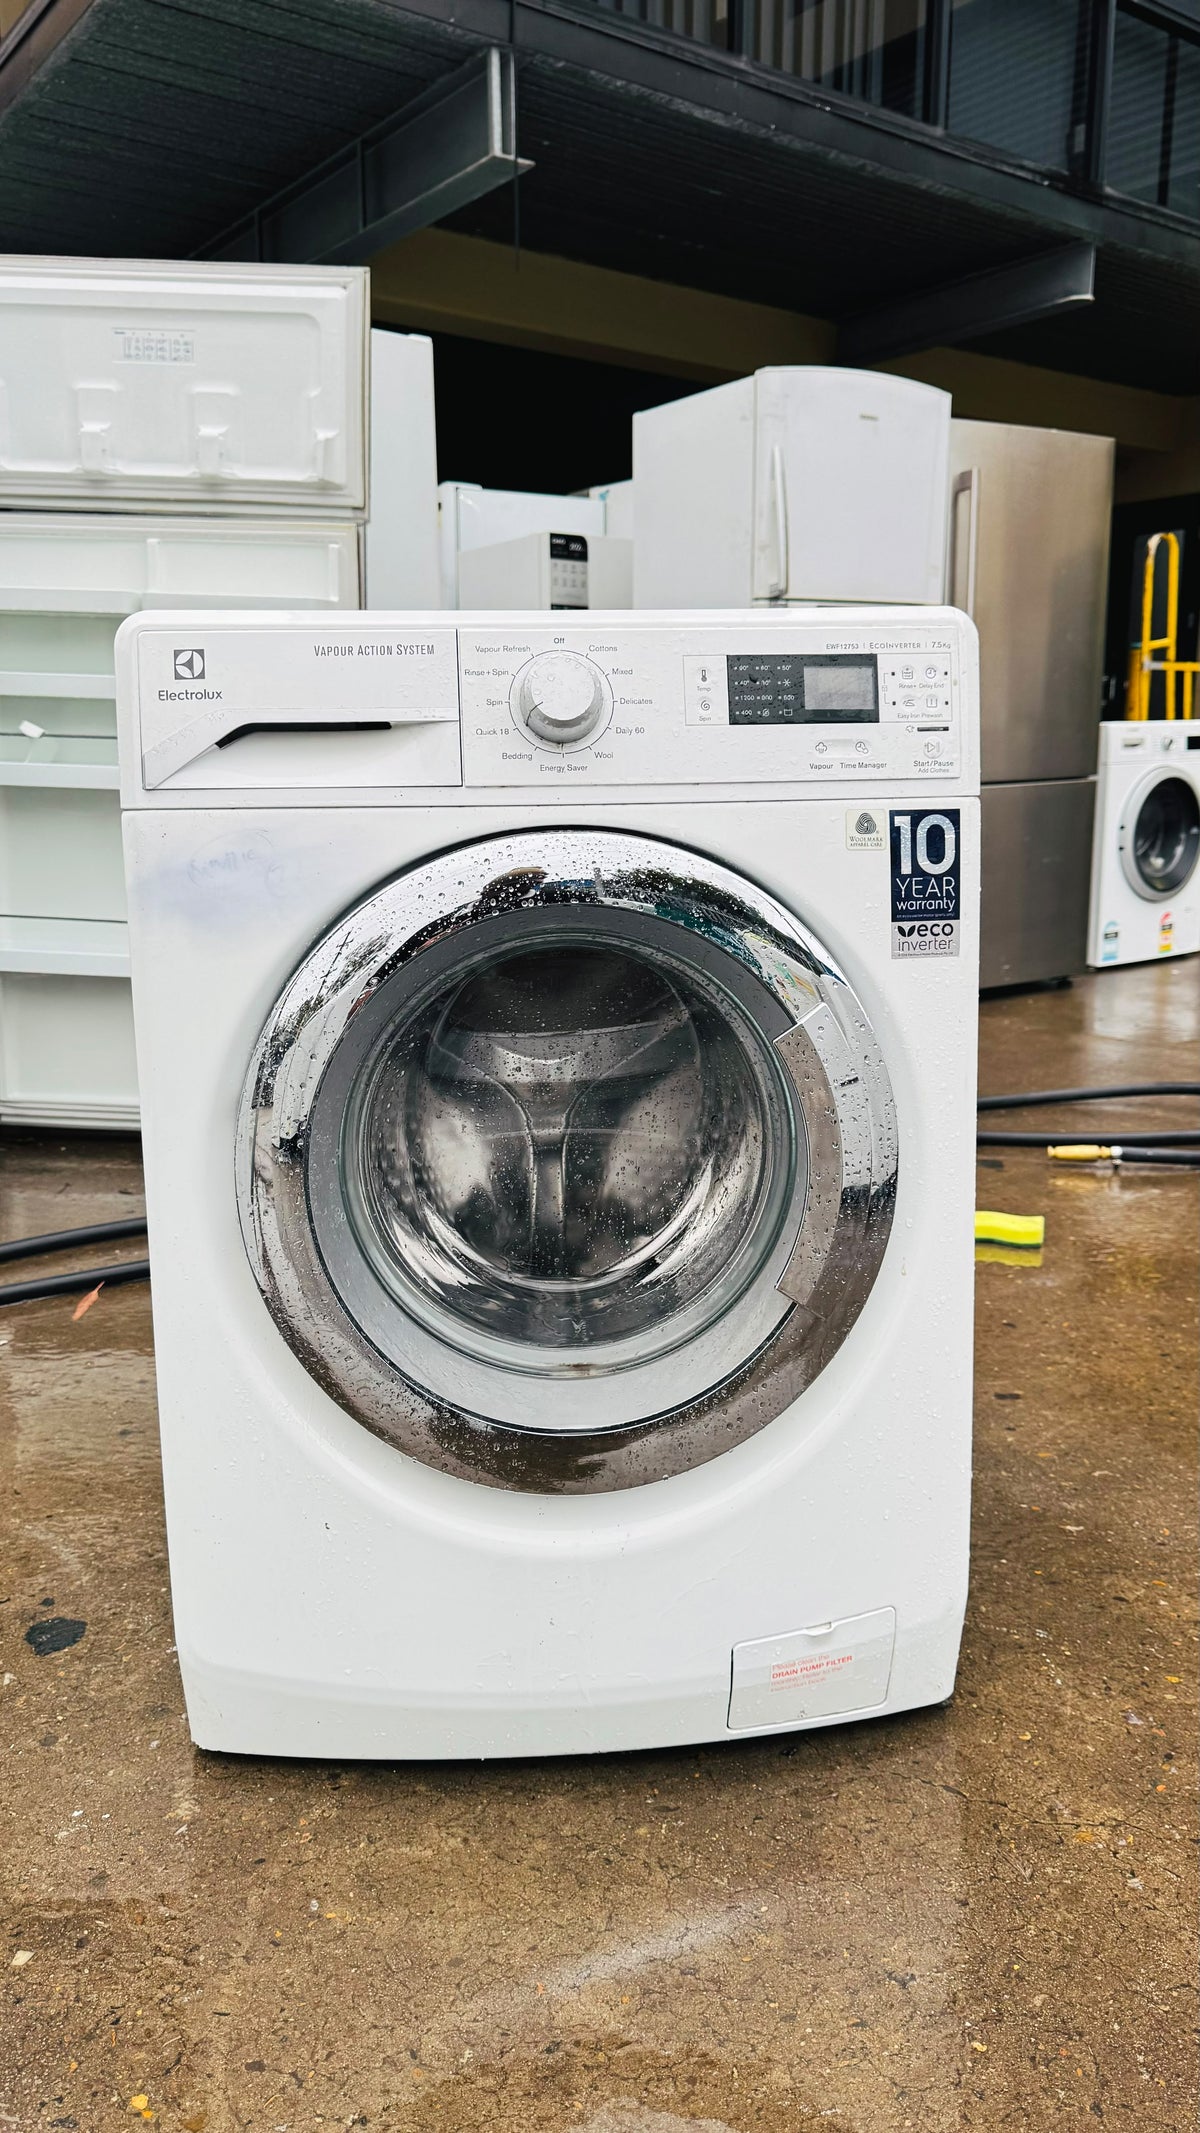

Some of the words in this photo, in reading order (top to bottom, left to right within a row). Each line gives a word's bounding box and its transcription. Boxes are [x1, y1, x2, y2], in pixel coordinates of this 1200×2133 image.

[475, 646, 501, 654] Vapour
[492, 669, 509, 677] Spin
[158, 689, 223, 702] Electrolux
[486, 699, 503, 707] Spin
[476, 728, 497, 736] Quick
[615, 727, 633, 735] Daily
[502, 752, 533, 761] Bedding
[540, 765, 565, 773] Energy
[567, 764, 588, 772] Saver
[809, 763, 833, 771] Vapour
[858, 762, 887, 770] Manager
[894, 813, 956, 875] 10
[896, 877, 956, 898] YEAR
[896, 897, 955, 912] warranty
[917, 923, 954, 937] eco
[898, 938, 953, 951] inverter
[772, 1669, 798, 1679] DRAIN
[800, 1662, 824, 1673] PUMP
[826, 1655, 853, 1667] FILTER
